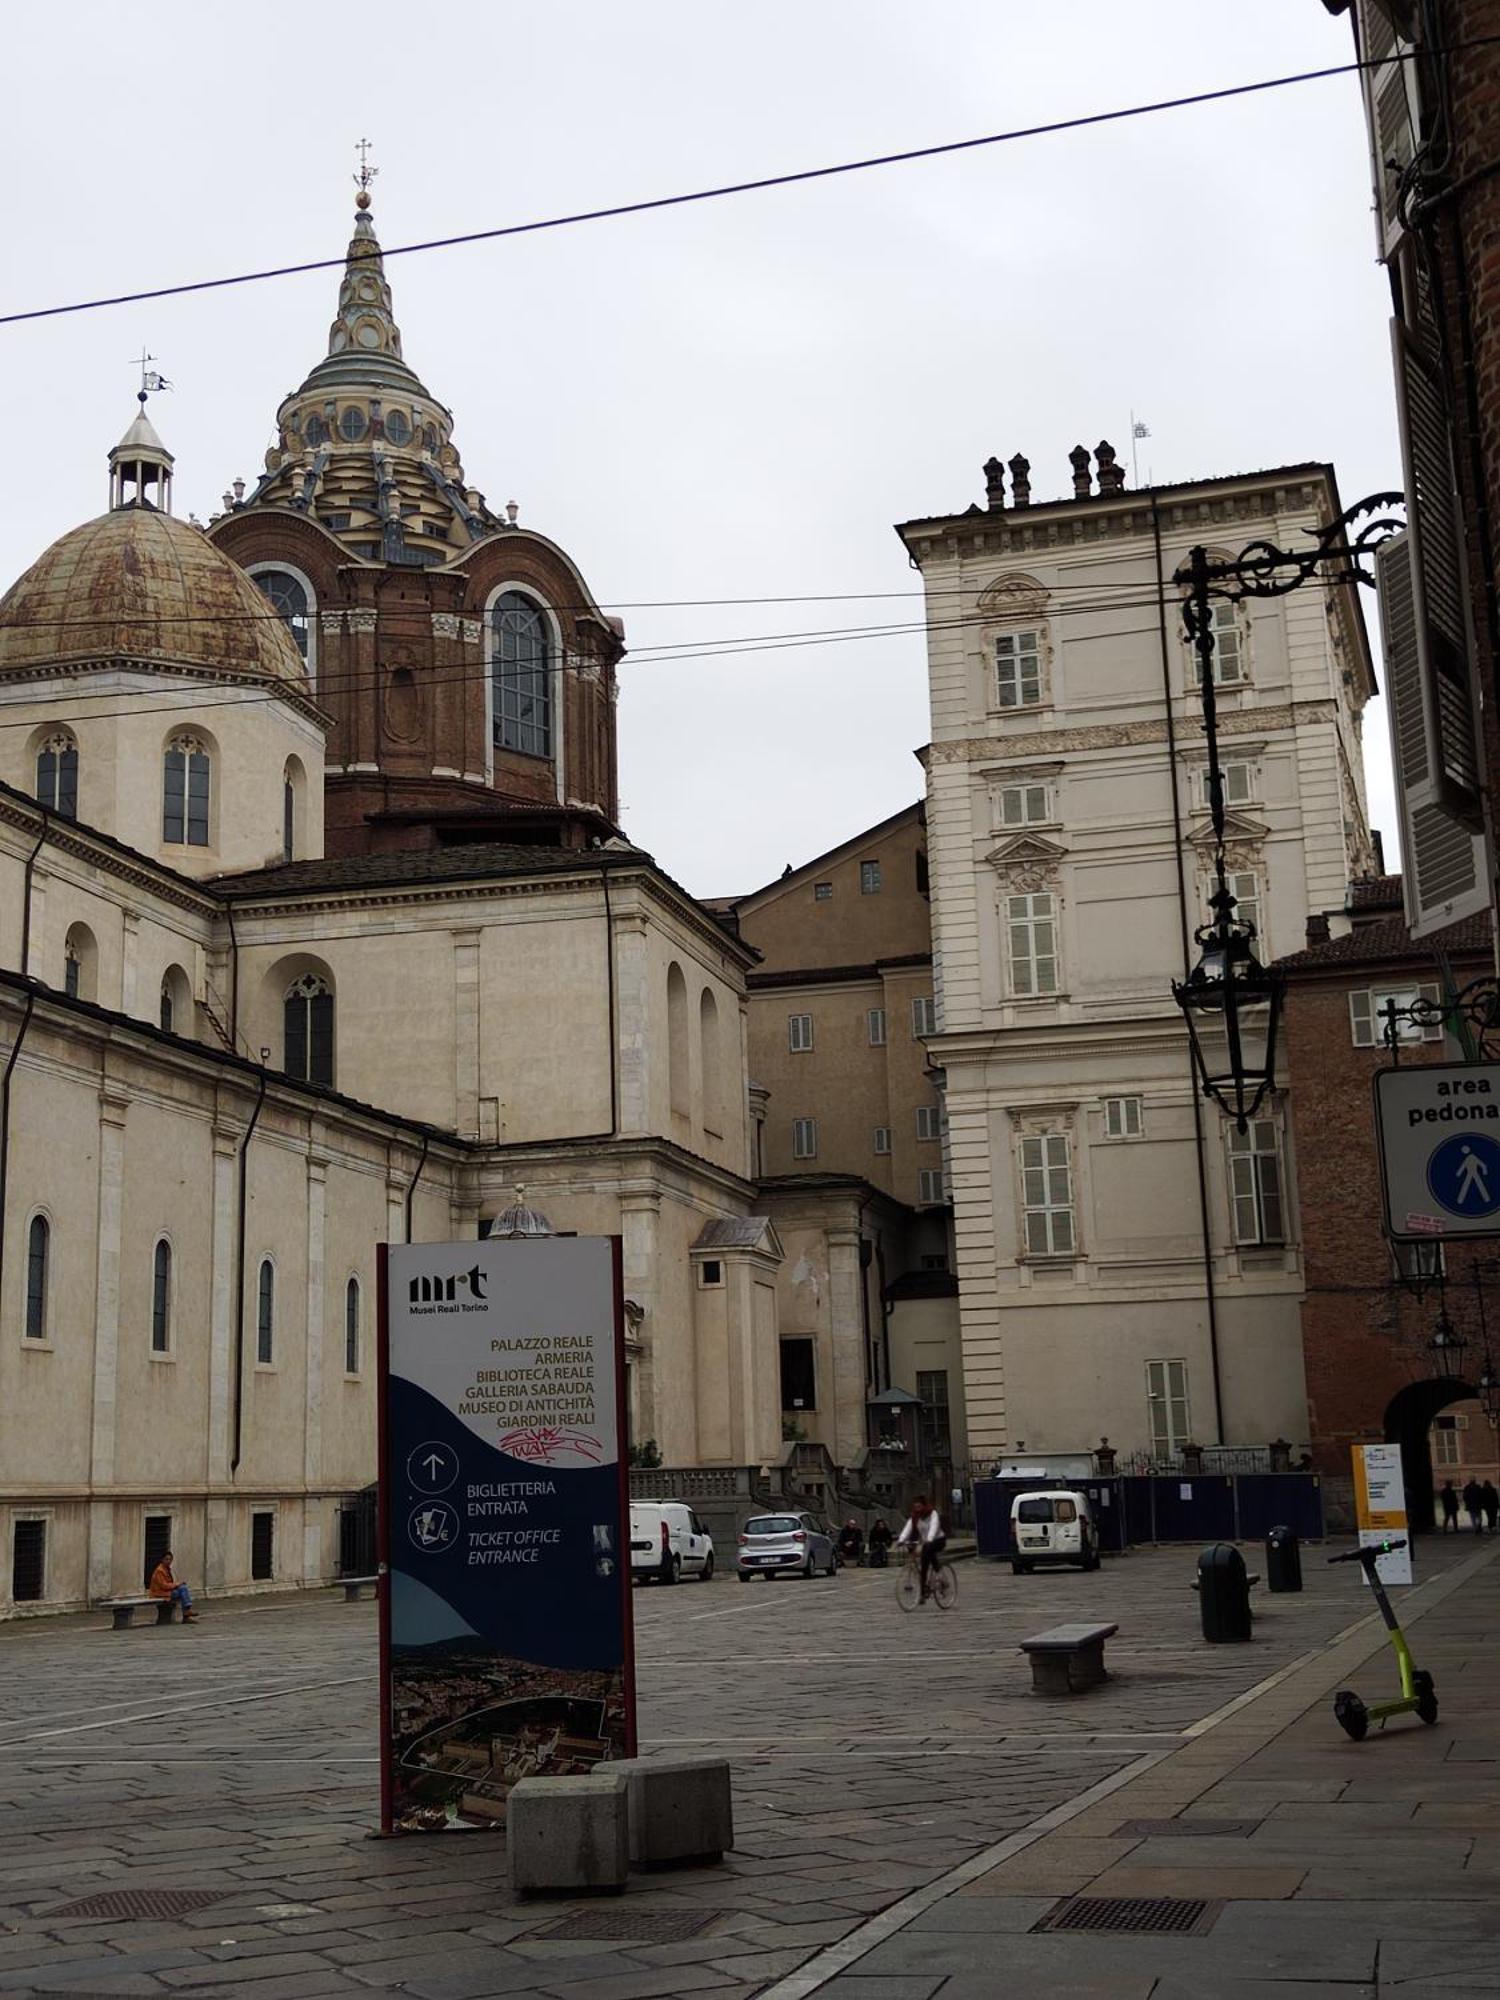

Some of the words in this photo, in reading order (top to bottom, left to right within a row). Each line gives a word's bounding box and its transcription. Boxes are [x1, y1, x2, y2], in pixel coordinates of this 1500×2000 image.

[1437, 1079, 1491, 1096] area
[410, 1265, 487, 1302] mrt
[410, 1306, 436, 1315] Musei
[438, 1305, 459, 1313] Reali
[461, 1304, 489, 1312] Torino
[490, 1338, 551, 1352] PALAZZO
[554, 1336, 594, 1349] REALE
[535, 1351, 594, 1365] ARMERIA
[477, 1368, 552, 1382] BIBLIOTECA
[554, 1367, 594, 1379] REALE
[465, 1385, 529, 1399] GALLERIA
[531, 1382, 594, 1395] SABAUDA
[459, 1401, 506, 1415] MUSEO
[509, 1400, 523, 1412] DI
[526, 1395, 595, 1411] ANTICHITÀ
[497, 1415, 557, 1428] GIARDINI
[558, 1413, 595, 1425] REALI
[467, 1481, 556, 1498] BIGLIETTERIA
[468, 1501, 528, 1516] ENTRATA
[469, 1531, 513, 1547] TICKET
[514, 1529, 560, 1544] OFFICE
[468, 1548, 540, 1565] ENTRANCE
